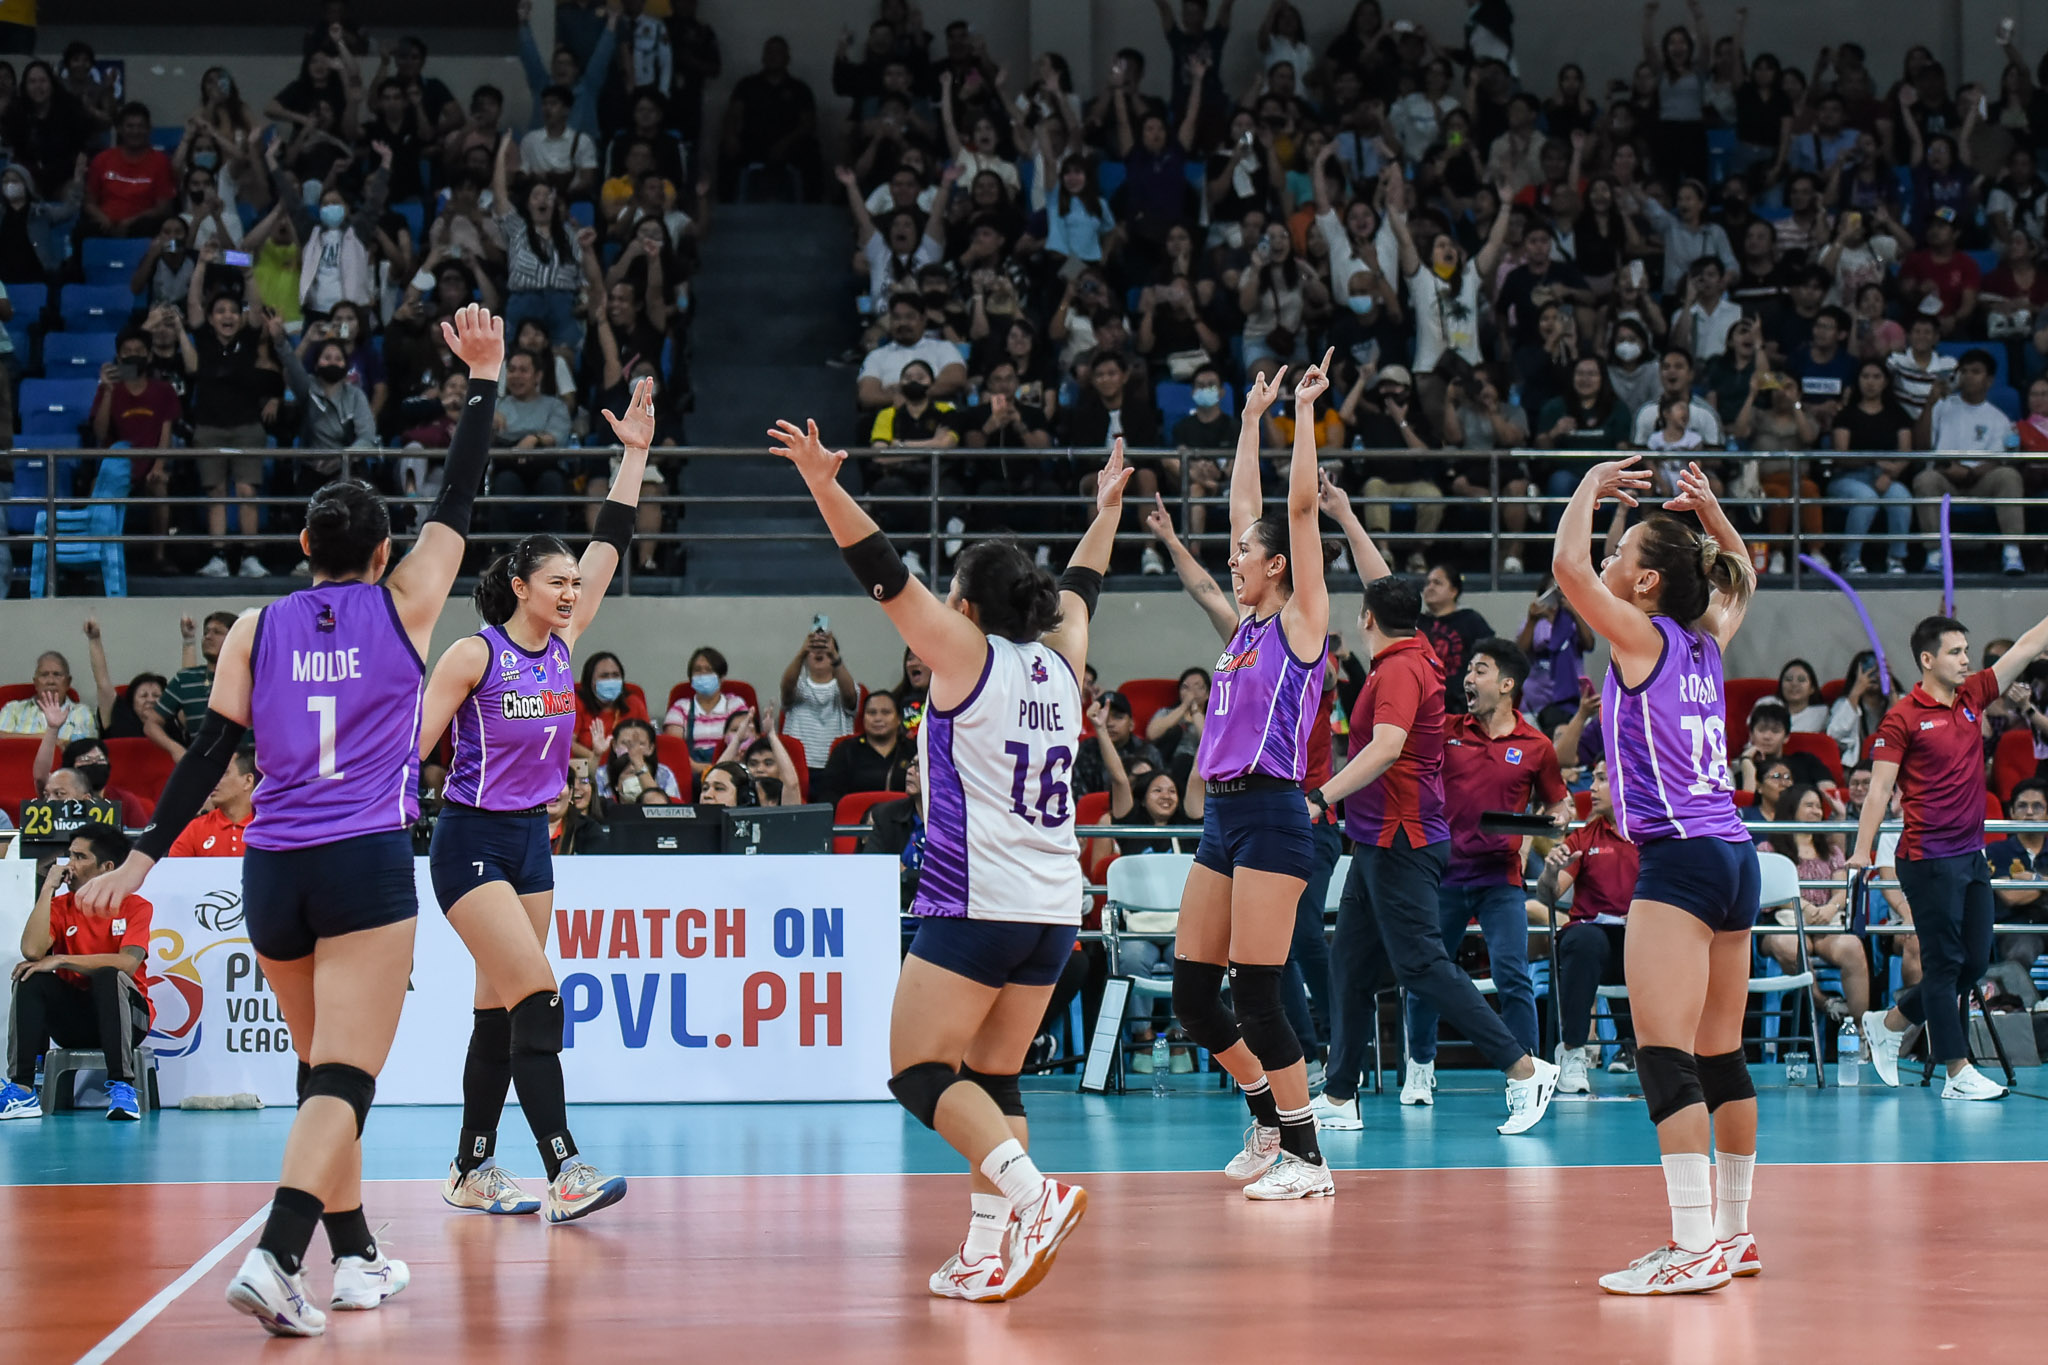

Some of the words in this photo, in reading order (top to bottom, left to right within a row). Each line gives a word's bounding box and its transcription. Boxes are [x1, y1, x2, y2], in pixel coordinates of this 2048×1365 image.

[292, 648, 362, 682] MOLDE
[306, 696, 345, 783] 1
[540, 725, 558, 760] 7
[1680, 715, 1735, 796] 18
[1004, 740, 1072, 828] 16
[24, 806, 52, 834] 23
[61, 804, 69, 818] 1
[73, 803, 83, 815] 2
[472, 861, 484, 876] 7
[555, 908, 746, 959] WATCH
[773, 907, 844, 958] ON
[560, 971, 842, 1049] PVL.PH
